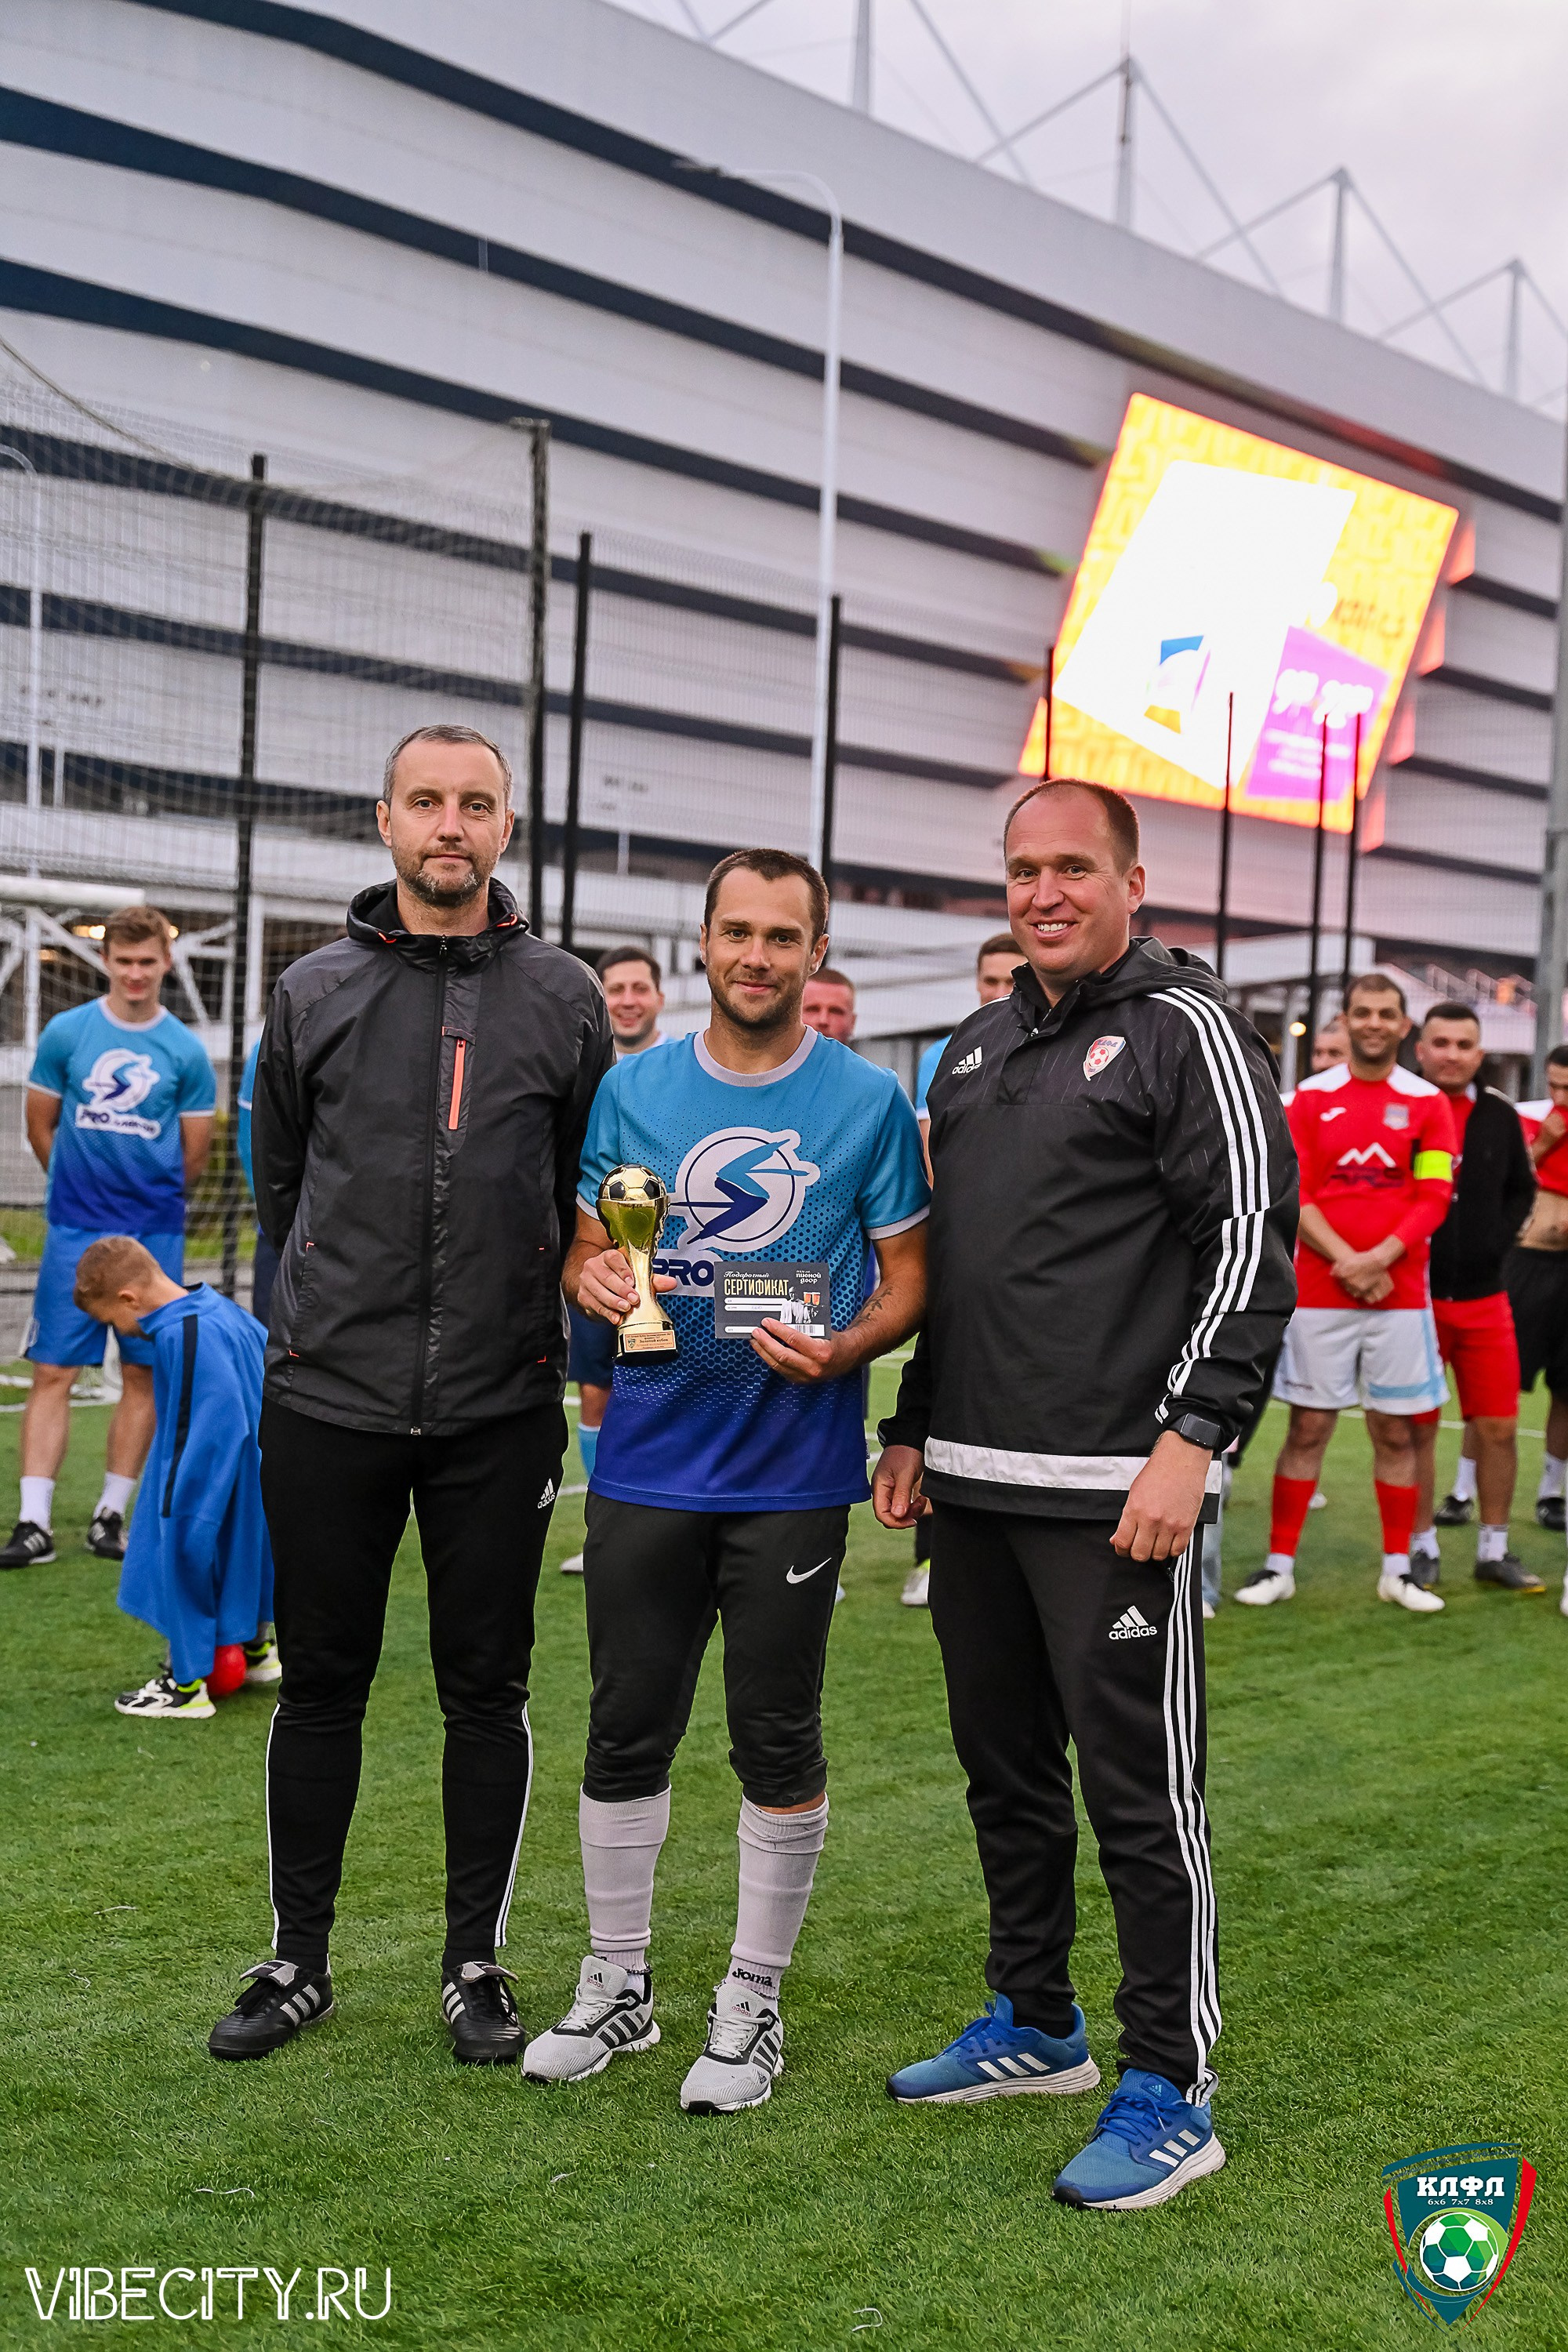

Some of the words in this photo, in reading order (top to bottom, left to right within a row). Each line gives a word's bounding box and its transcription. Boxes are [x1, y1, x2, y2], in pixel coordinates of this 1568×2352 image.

[724, 1271, 769, 1279] Подарочный
[724, 1279, 789, 1296] СЕРТИФИКАТ
[1109, 1626, 1158, 1640] adidas
[586, 1977, 604, 1989] adidas
[731, 1967, 773, 1987] Joma
[731, 2005, 751, 2017] adidas
